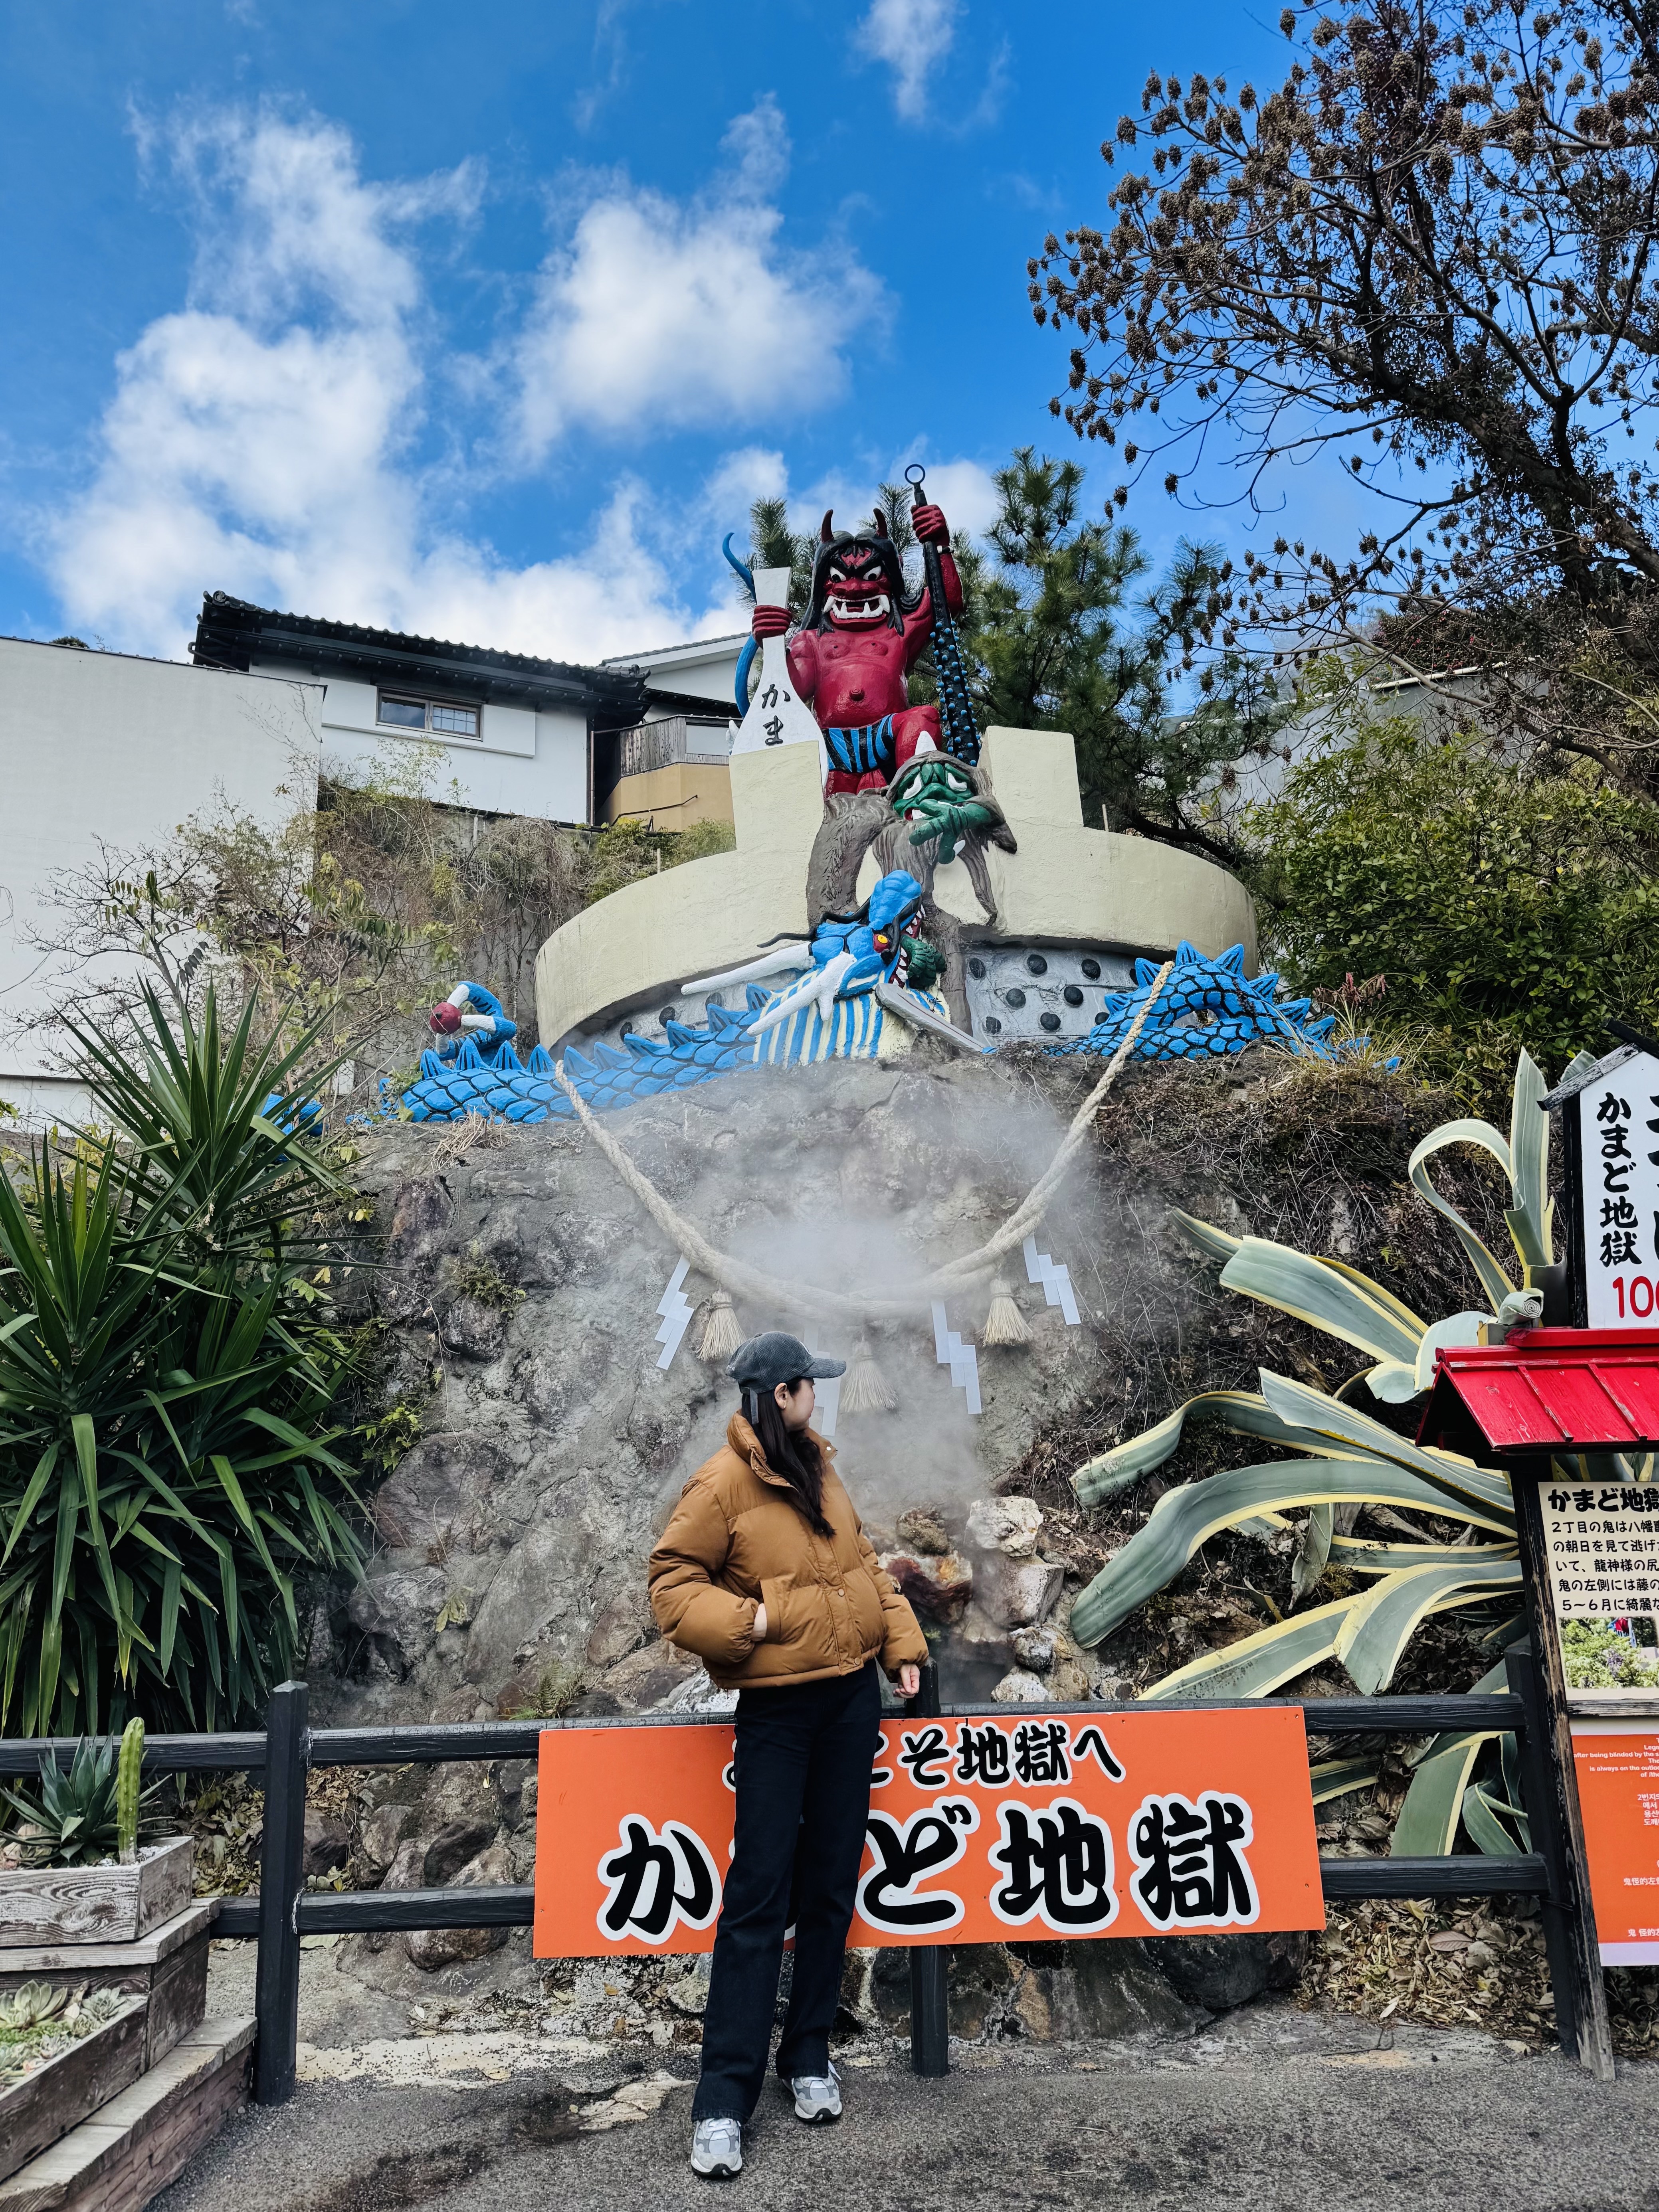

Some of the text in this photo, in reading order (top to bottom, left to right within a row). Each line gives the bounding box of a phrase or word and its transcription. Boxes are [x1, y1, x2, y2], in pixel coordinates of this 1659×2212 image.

[761, 683, 791, 746] かま
[1596, 1092, 1642, 1266] かまど地獄
[1613, 1276, 1659, 1318] 10
[1553, 1539, 1659, 1553] の朝日を見て逃げ
[723, 1721, 1121, 1784] そ地獄へ
[604, 1798, 1253, 1939] かど地獄
